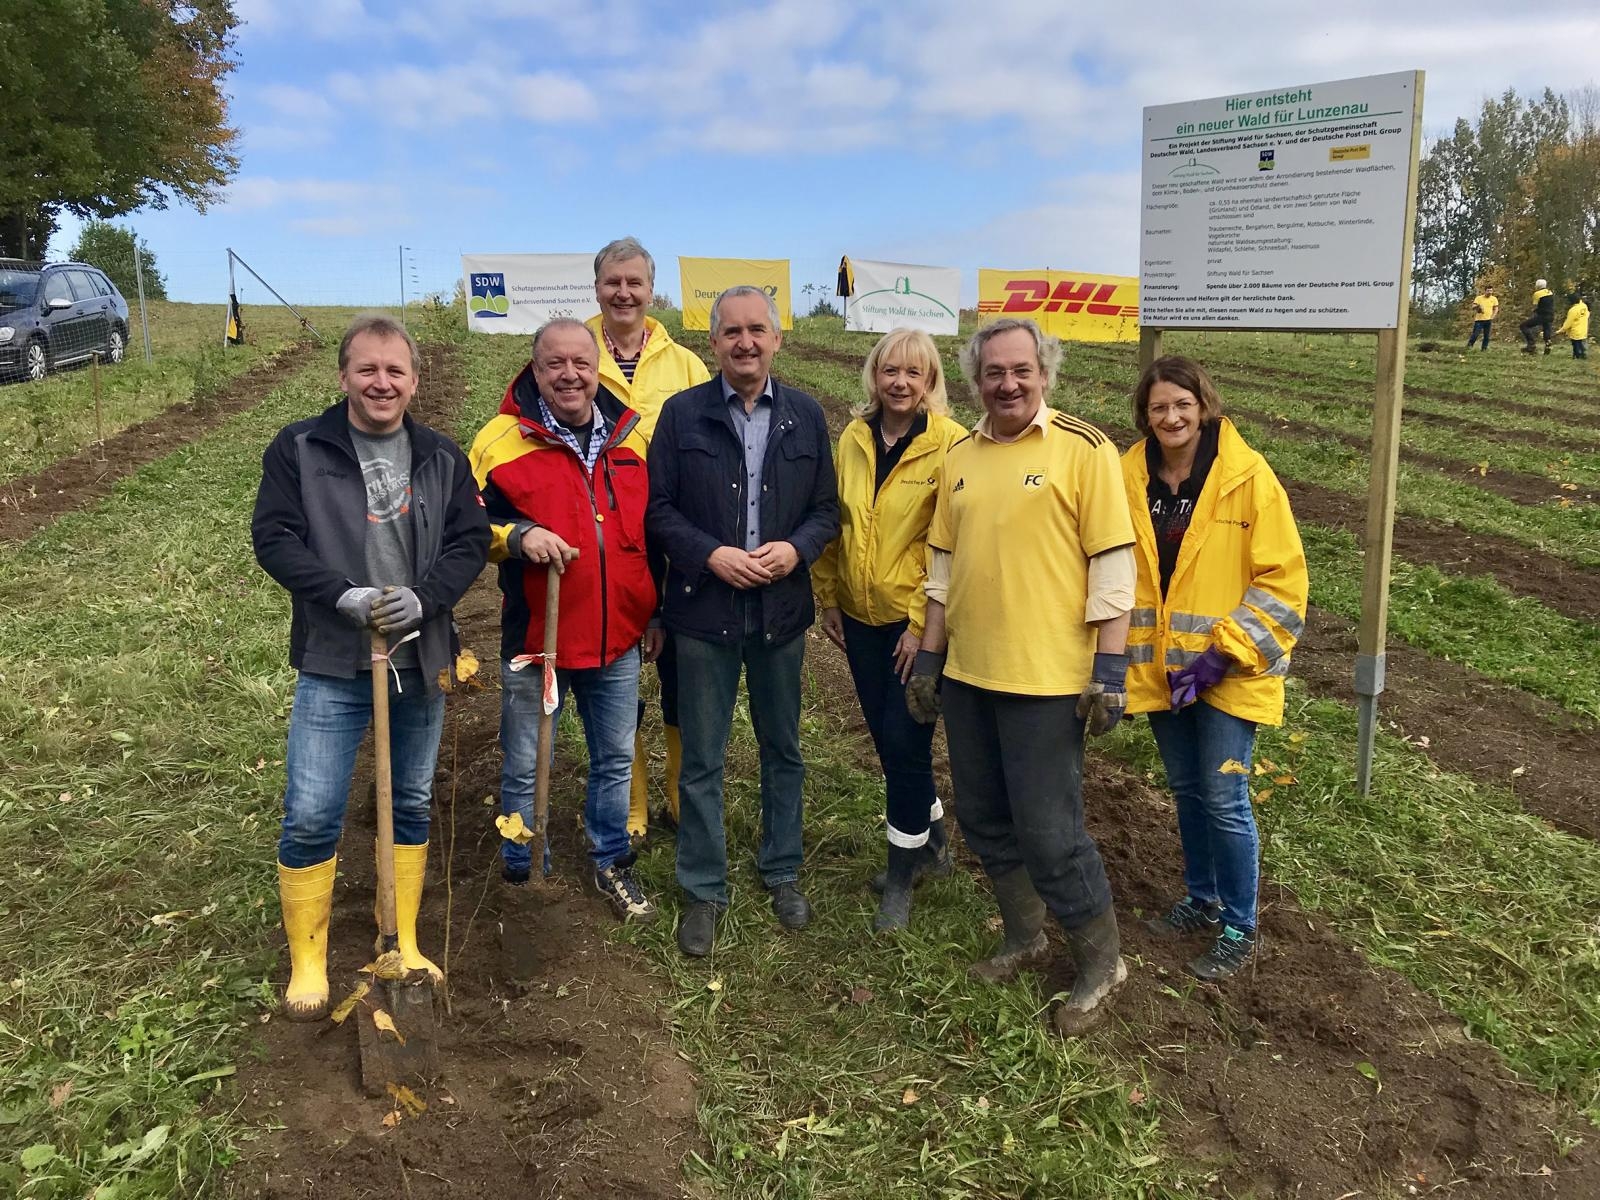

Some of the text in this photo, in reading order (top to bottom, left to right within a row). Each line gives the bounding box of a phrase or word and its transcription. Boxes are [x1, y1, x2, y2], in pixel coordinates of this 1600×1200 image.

[1226, 89, 1312, 112] Hier entsteht
[1176, 103, 1368, 134] ein neuer Wald für Lunzenau
[1150, 150, 1178, 158] Deutscher
[1180, 148, 1196, 156] Wald,
[1196, 144, 1242, 154] Landesverband
[1242, 142, 1268, 150] Sachsen
[1312, 134, 1344, 142] Deutsche
[1379, 127, 1402, 136] Group
[1179, 141, 1200, 149] Projekt
[1212, 138, 1236, 146] Stiftung
[1265, 131, 1294, 140] Sachsen,
[1308, 121, 1378, 134] Schutzgemeinschaft
[1276, 170, 1314, 179] Arrondierung
[1316, 168, 1354, 176] bestehender
[475, 277, 500, 286] SDW
[1002, 280, 1122, 316] DHL
[862, 304, 944, 318] Stiftung Wald für Sachsen
[1024, 474, 1043, 486] FC
